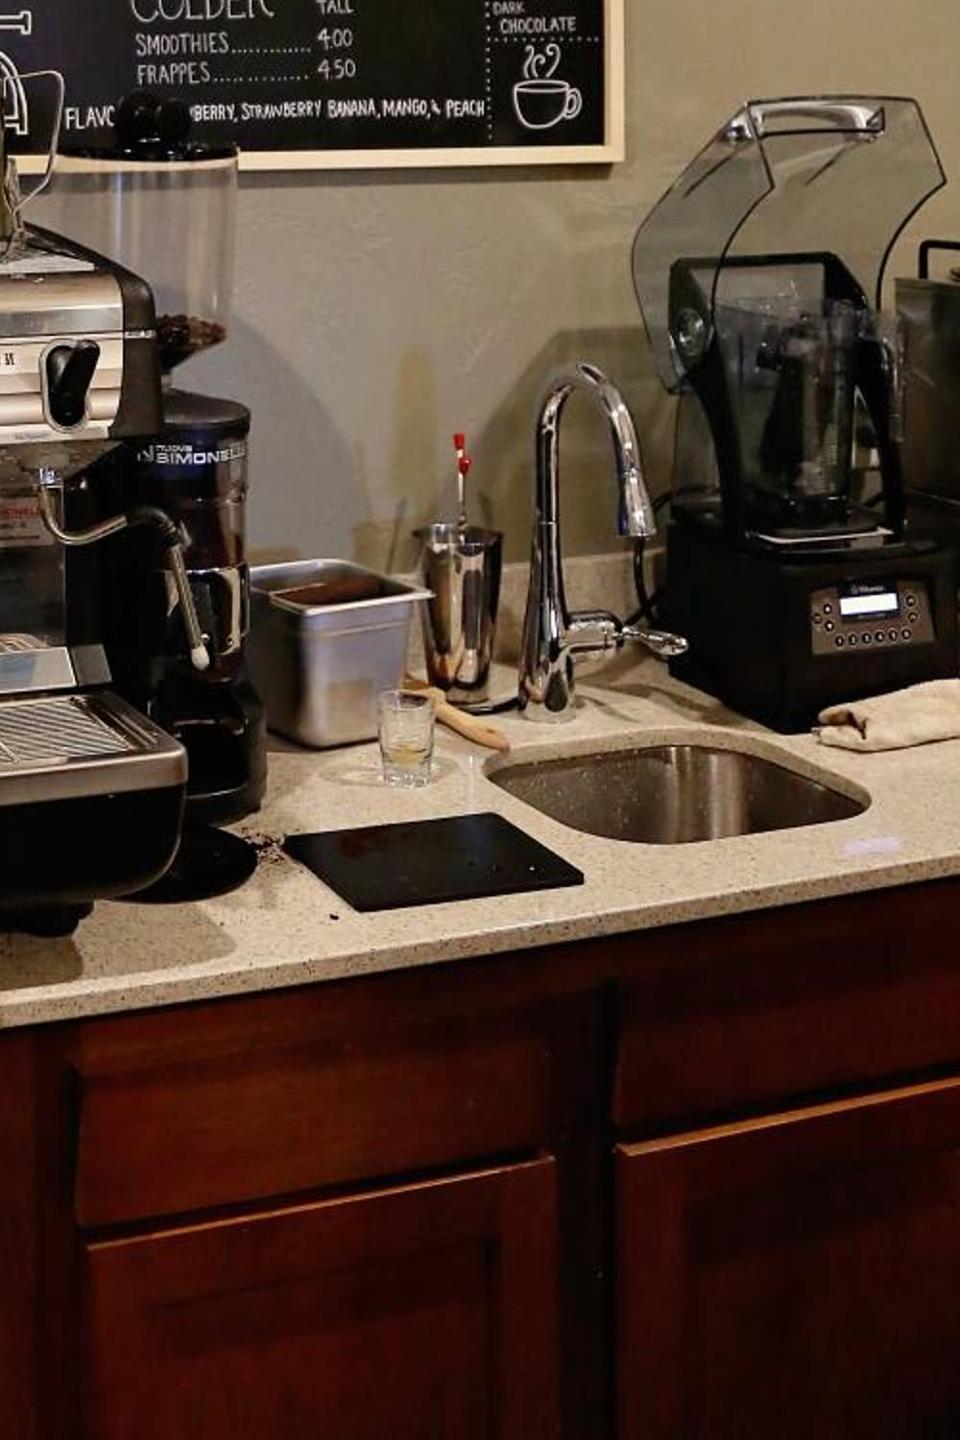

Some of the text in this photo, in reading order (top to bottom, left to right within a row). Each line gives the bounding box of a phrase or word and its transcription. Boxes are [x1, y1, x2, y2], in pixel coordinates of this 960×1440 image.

[492, 1, 525, 16] DARK
[500, 16, 578, 35] CHOCOLATE
[135, 28, 354, 57] SMOOTHIES 4.00
[137, 61, 212, 86] FRAPPES
[190, 103, 239, 123] BERRY,
[241, 100, 322, 122] STRAWBERRY
[327, 97, 382, 120] BANANA,
[382, 97, 432, 120] MANGO,
[446, 99, 486, 120] PEACH
